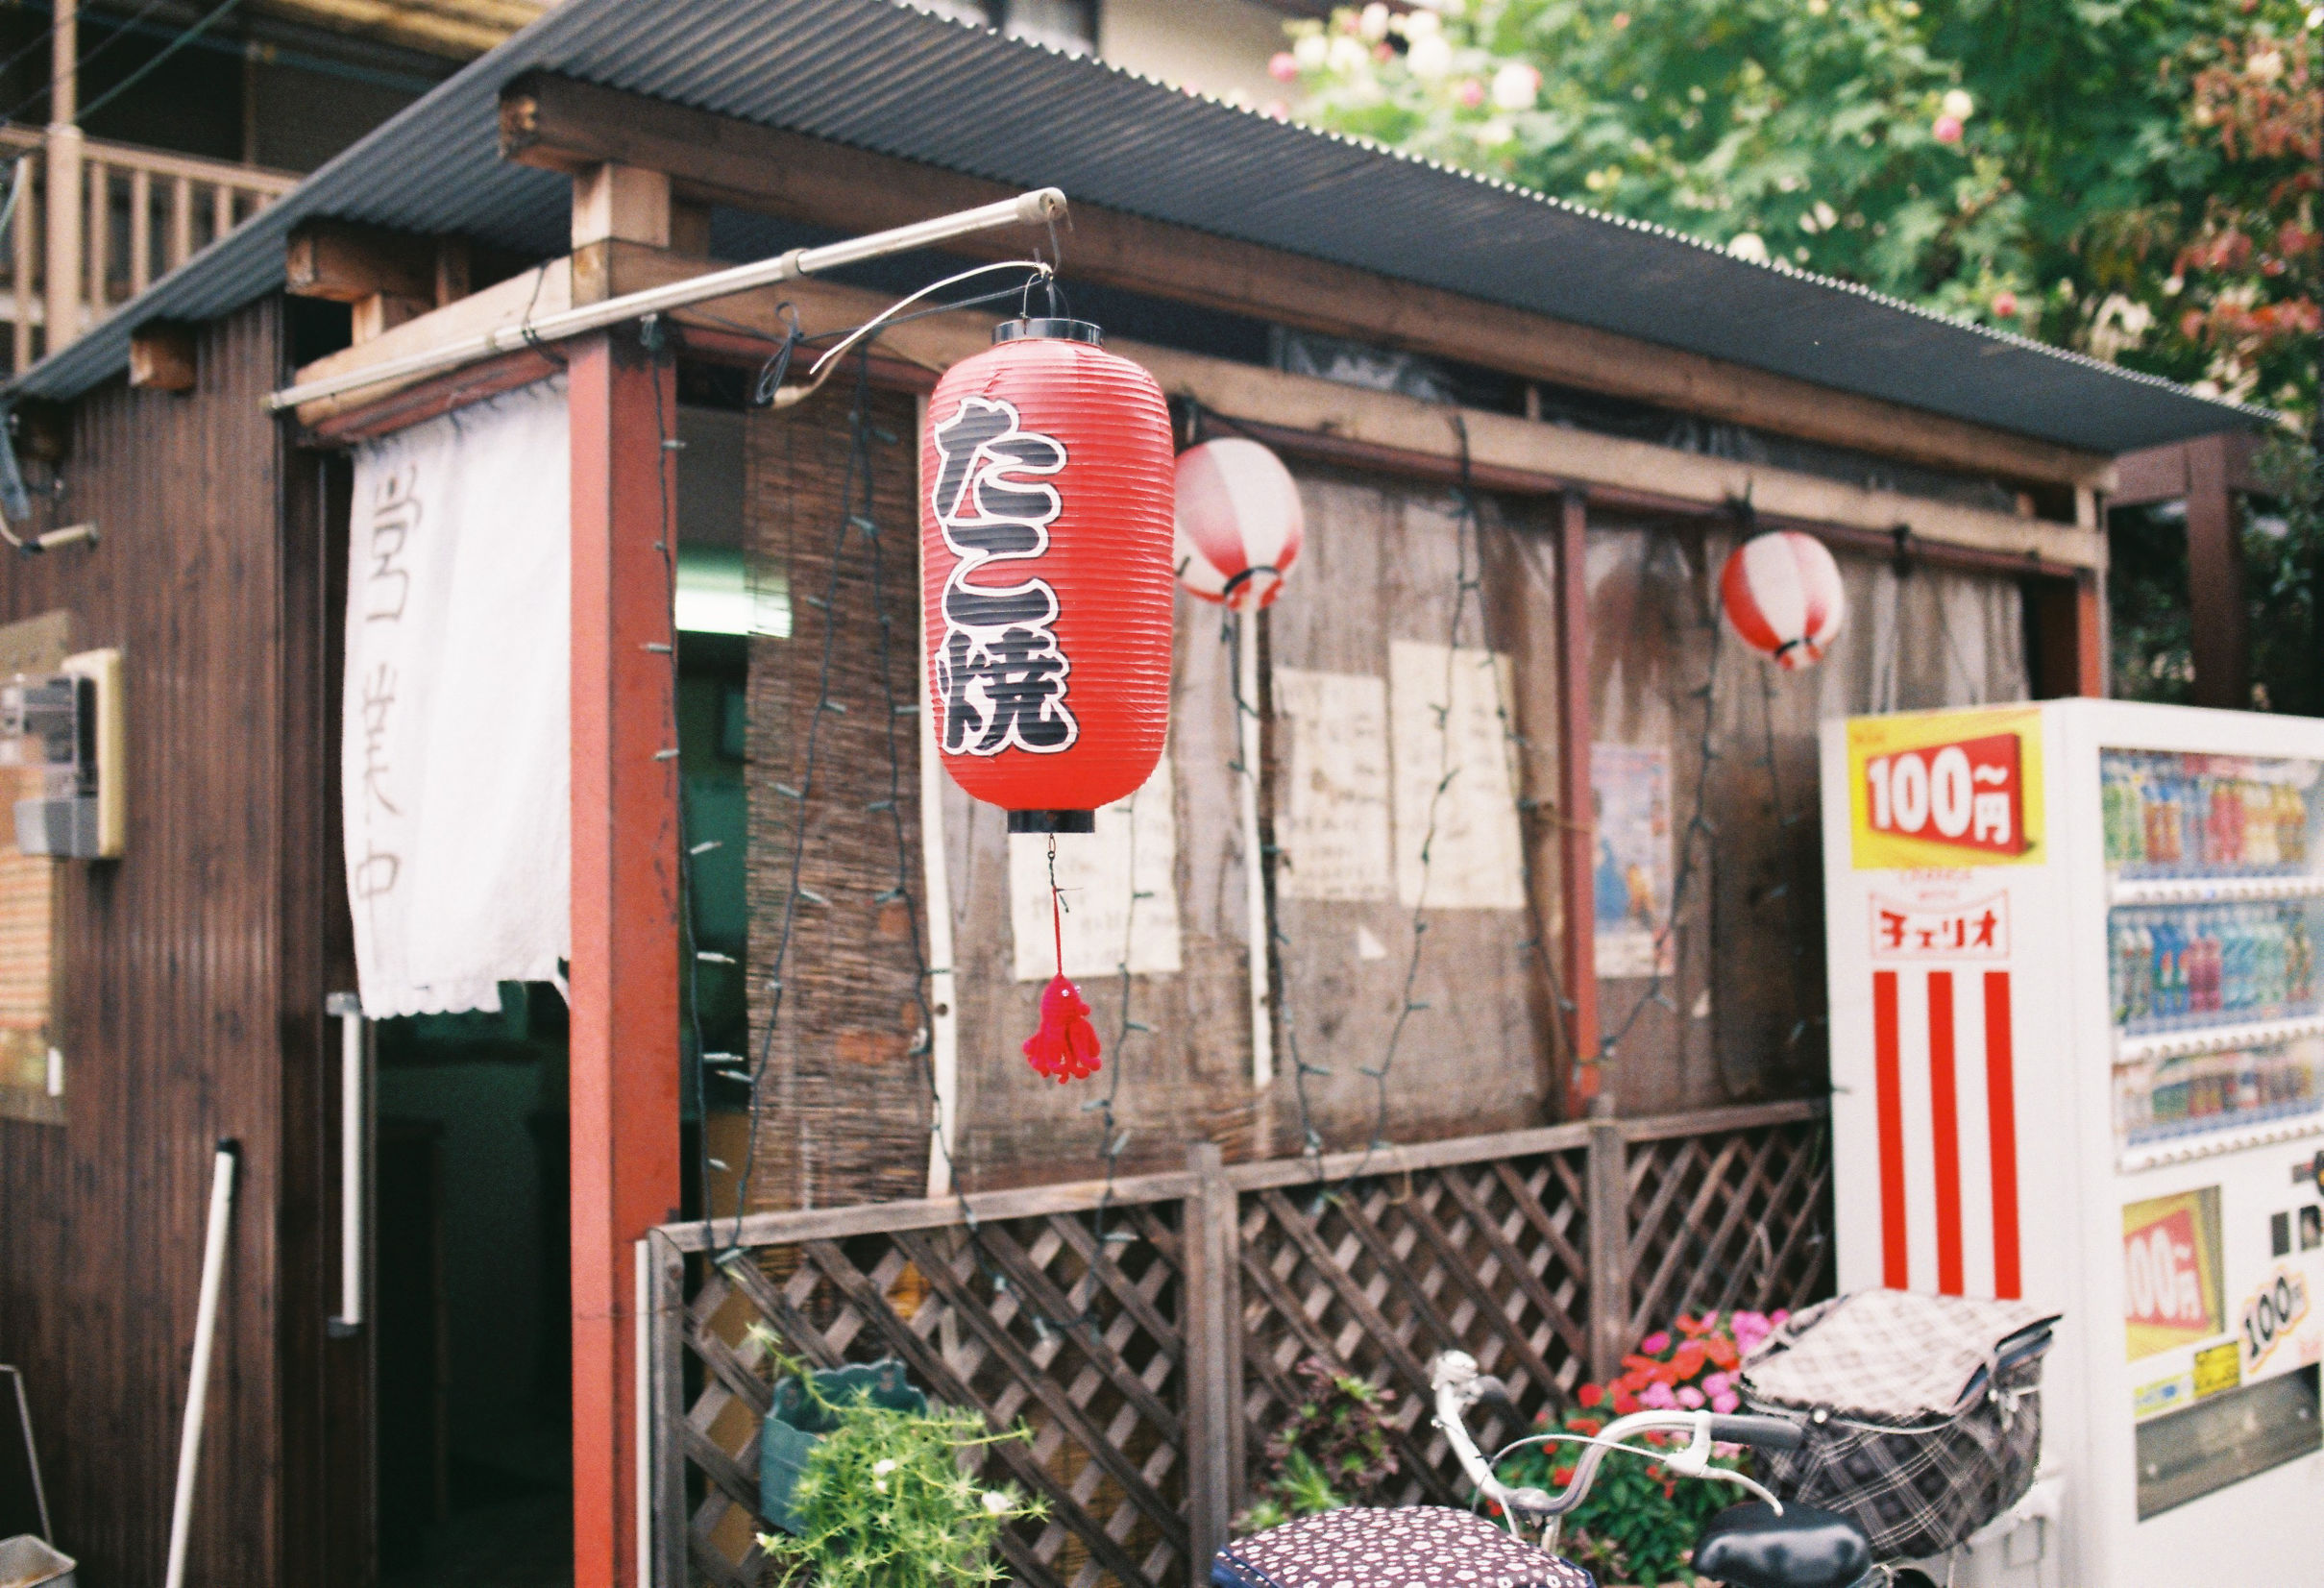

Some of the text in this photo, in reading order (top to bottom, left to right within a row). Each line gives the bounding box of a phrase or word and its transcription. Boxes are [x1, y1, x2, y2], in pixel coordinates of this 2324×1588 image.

[932, 396, 1079, 756] たこ焼
[1879, 910, 1998, 949] チェリオ
